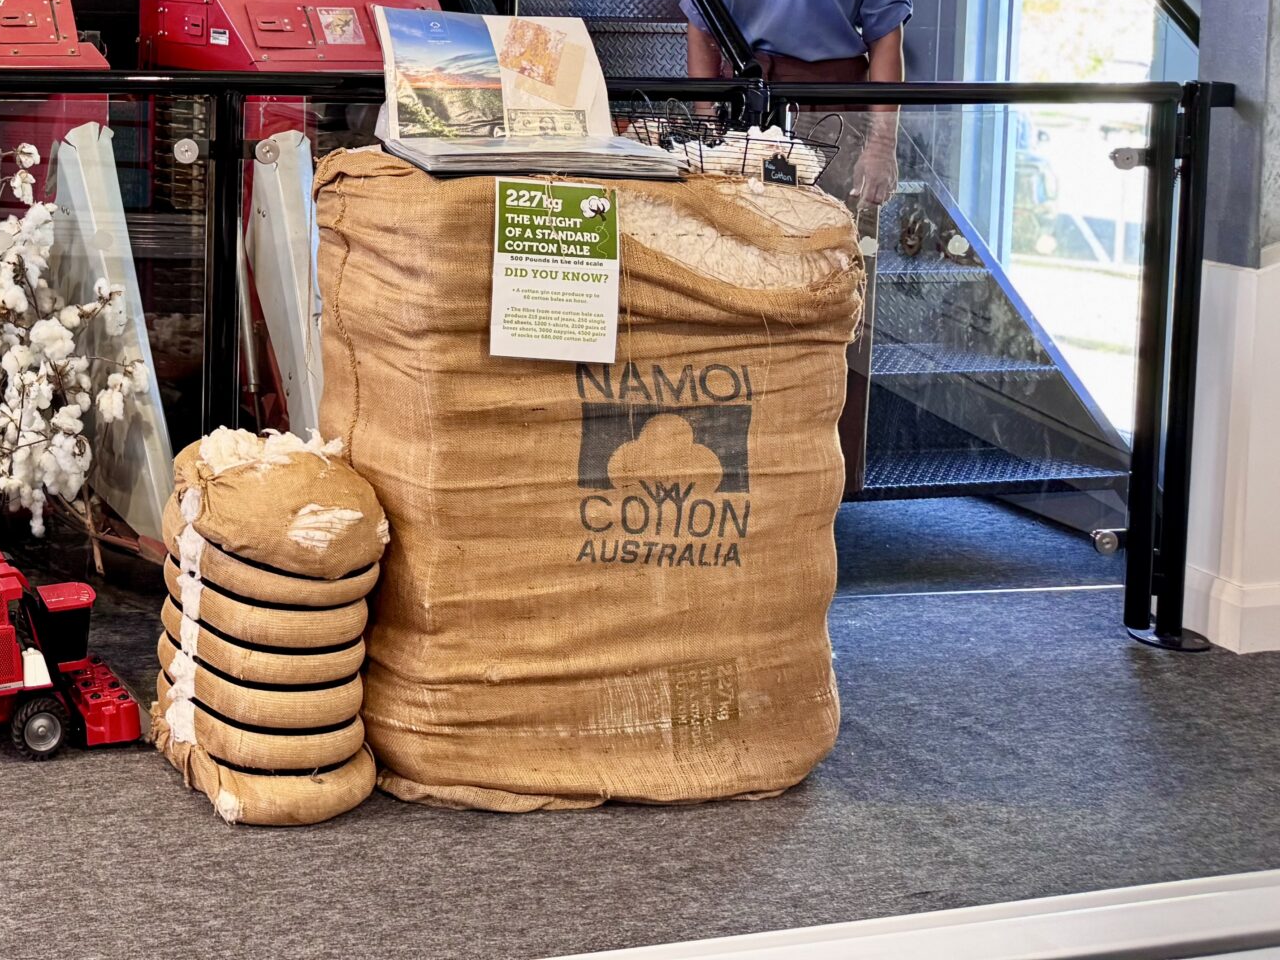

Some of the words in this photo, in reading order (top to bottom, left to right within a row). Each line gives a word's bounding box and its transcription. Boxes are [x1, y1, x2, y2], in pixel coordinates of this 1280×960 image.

[771, 171, 793, 182] Cotton
[505, 188, 563, 213] 227kg
[505, 213, 530, 225] THE
[532, 214, 583, 229] WEIGHT
[505, 227, 522, 238] OF
[524, 228, 534, 239] A
[536, 229, 600, 243] STANDARD
[505, 240, 557, 253] COTTON
[560, 244, 591, 256] BALE
[525, 256, 551, 264] Pounds
[504, 267, 528, 278] DID
[531, 269, 559, 280] YOU
[562, 271, 609, 283] KNOW?
[562, 290, 585, 298] produce
[575, 361, 753, 403] NAMOI
[579, 480, 751, 538] COTTON
[575, 538, 741, 568] AUSTRALIA
